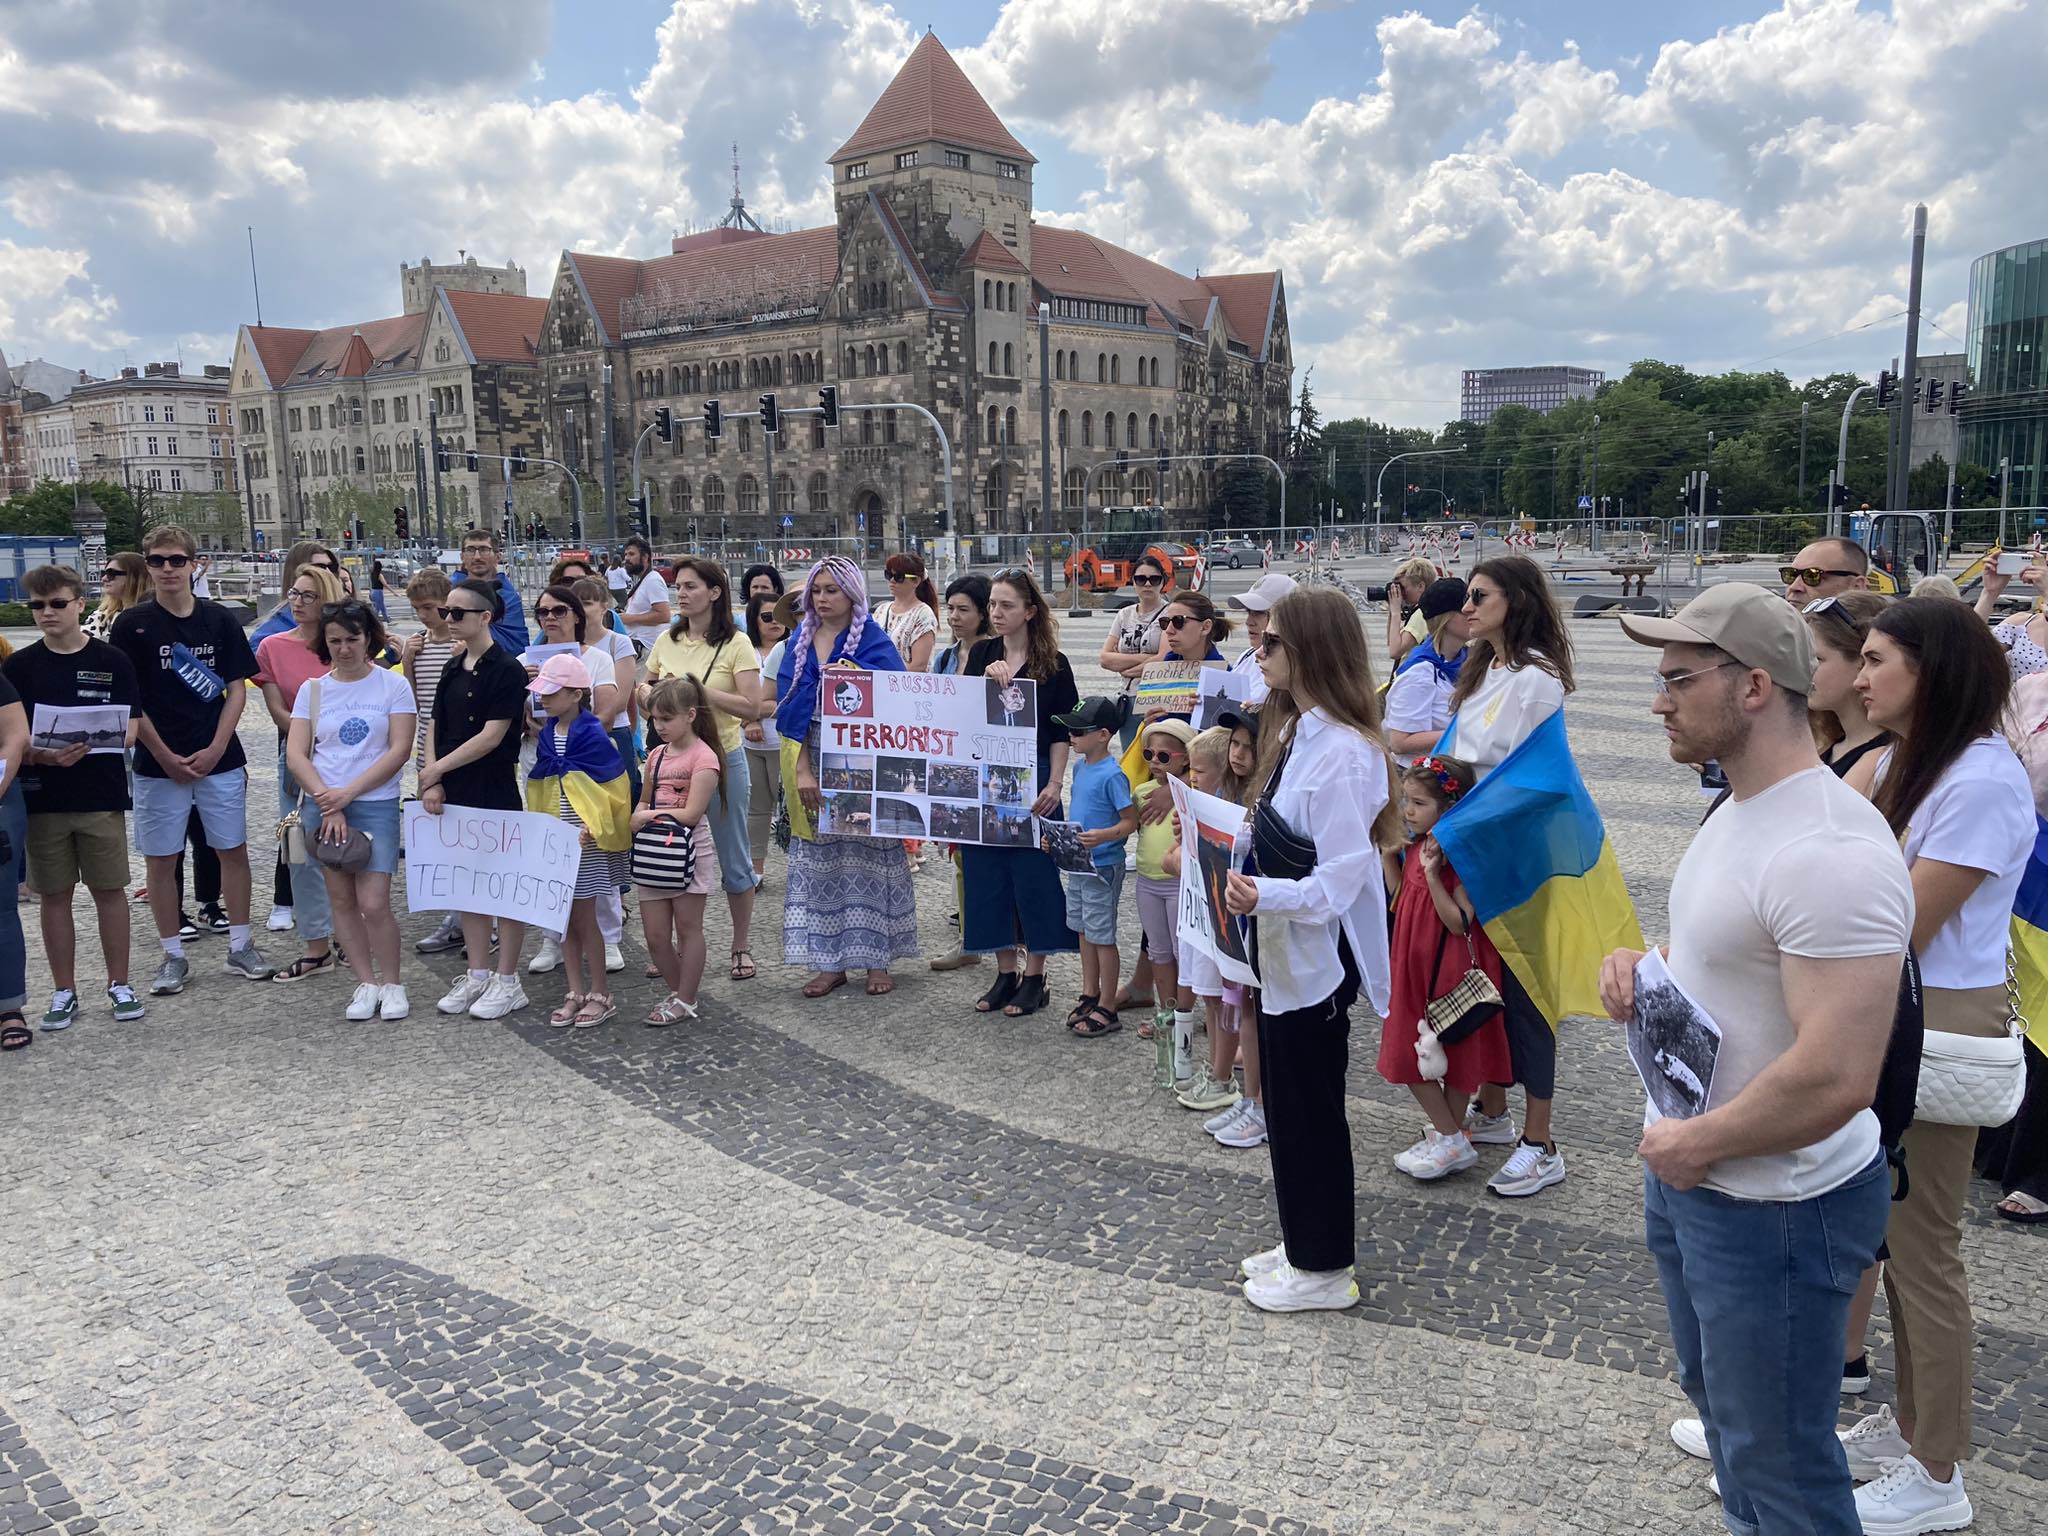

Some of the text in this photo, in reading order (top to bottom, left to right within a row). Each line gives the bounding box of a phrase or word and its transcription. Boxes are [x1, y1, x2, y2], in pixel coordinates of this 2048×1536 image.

[888, 674, 956, 696] RUSSIA
[915, 700, 934, 722] IS
[831, 723, 1037, 768] TERRORIST STATE
[542, 828, 557, 865] IS
